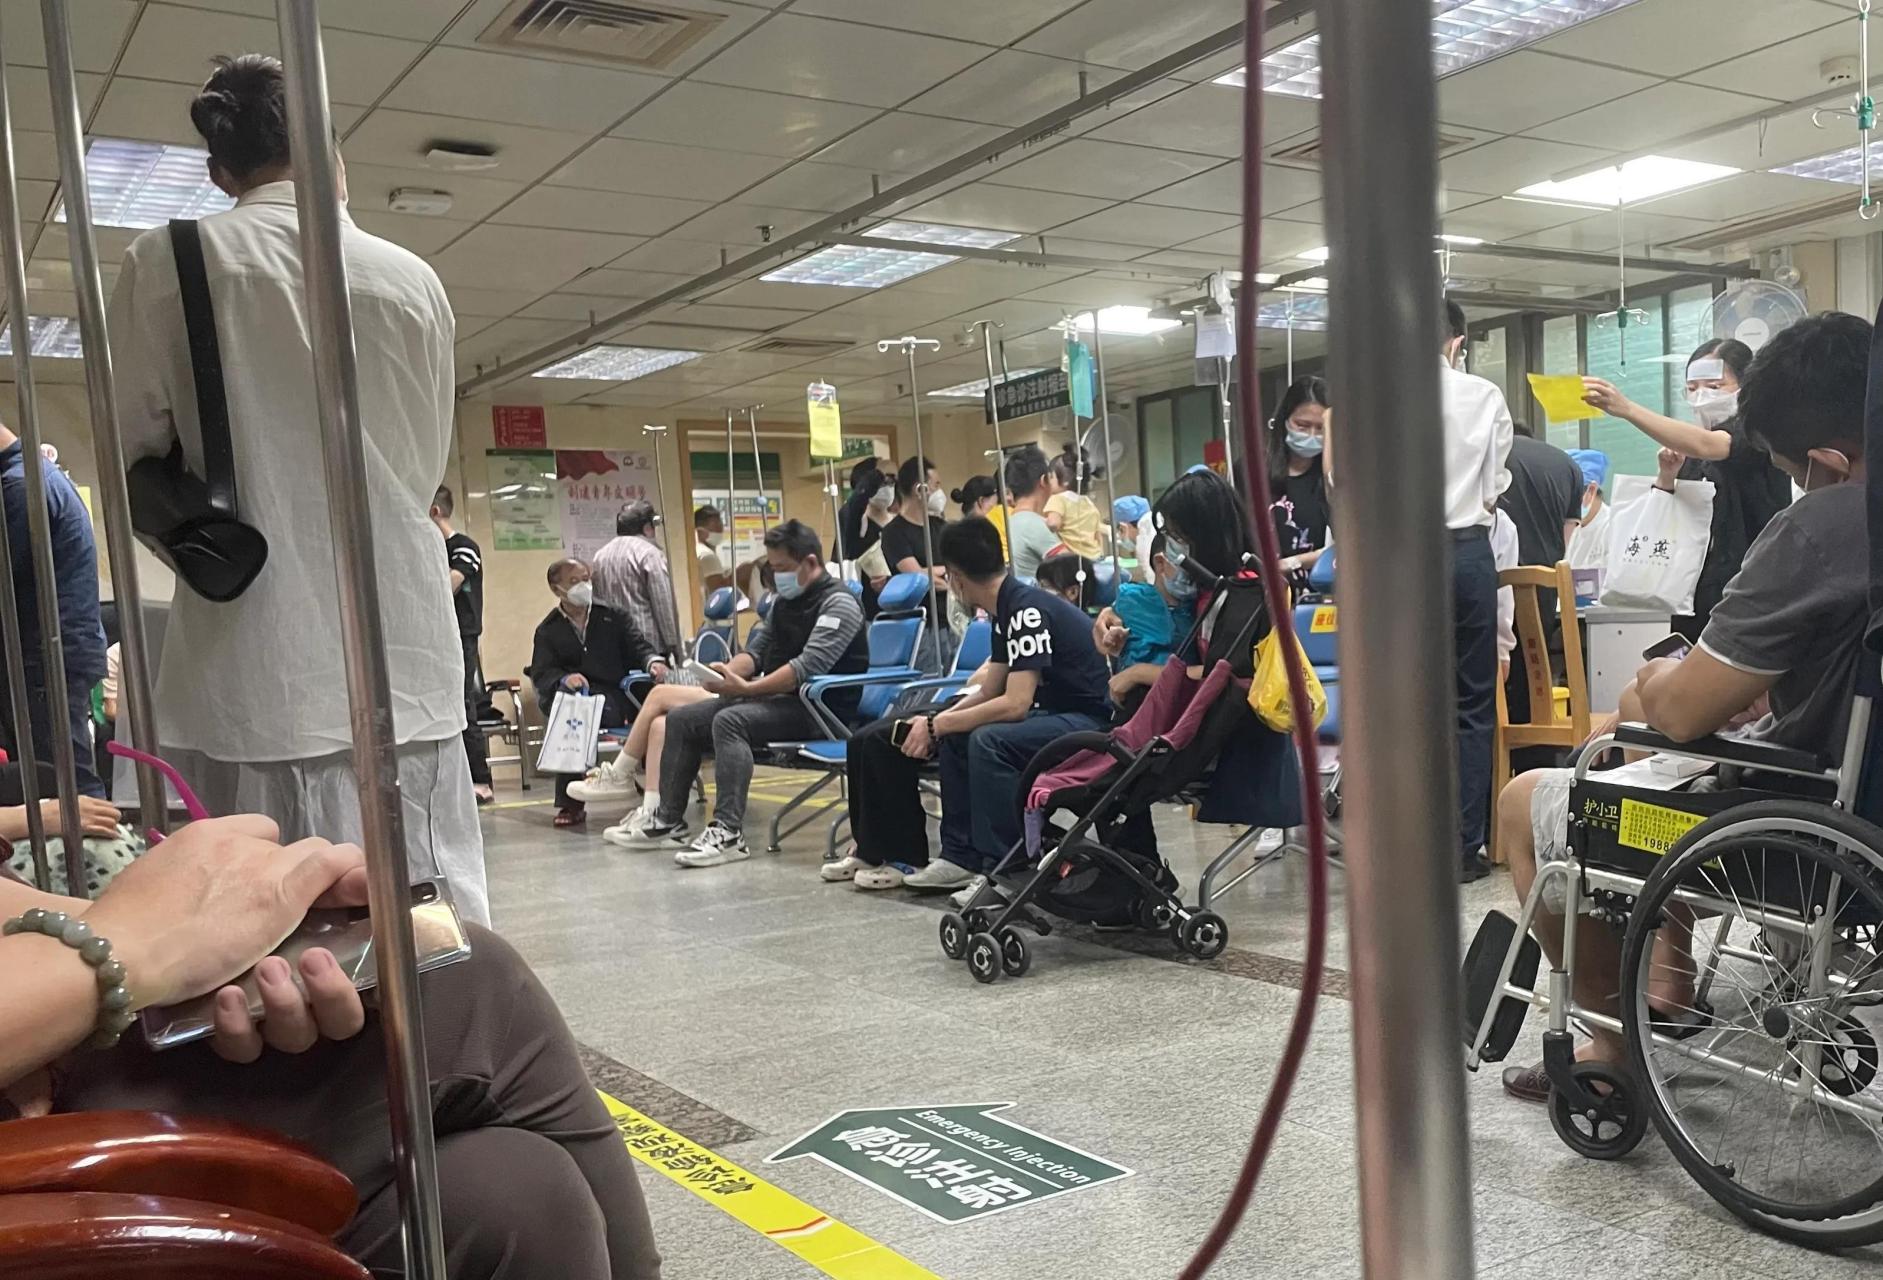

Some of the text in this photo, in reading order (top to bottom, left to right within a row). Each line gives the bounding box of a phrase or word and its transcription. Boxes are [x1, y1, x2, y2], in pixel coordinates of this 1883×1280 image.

[1583, 797, 1619, 819] 护小卫
[832, 1125, 1033, 1209] 急诊注射
[914, 1110, 1092, 1185] Emergency Injection
